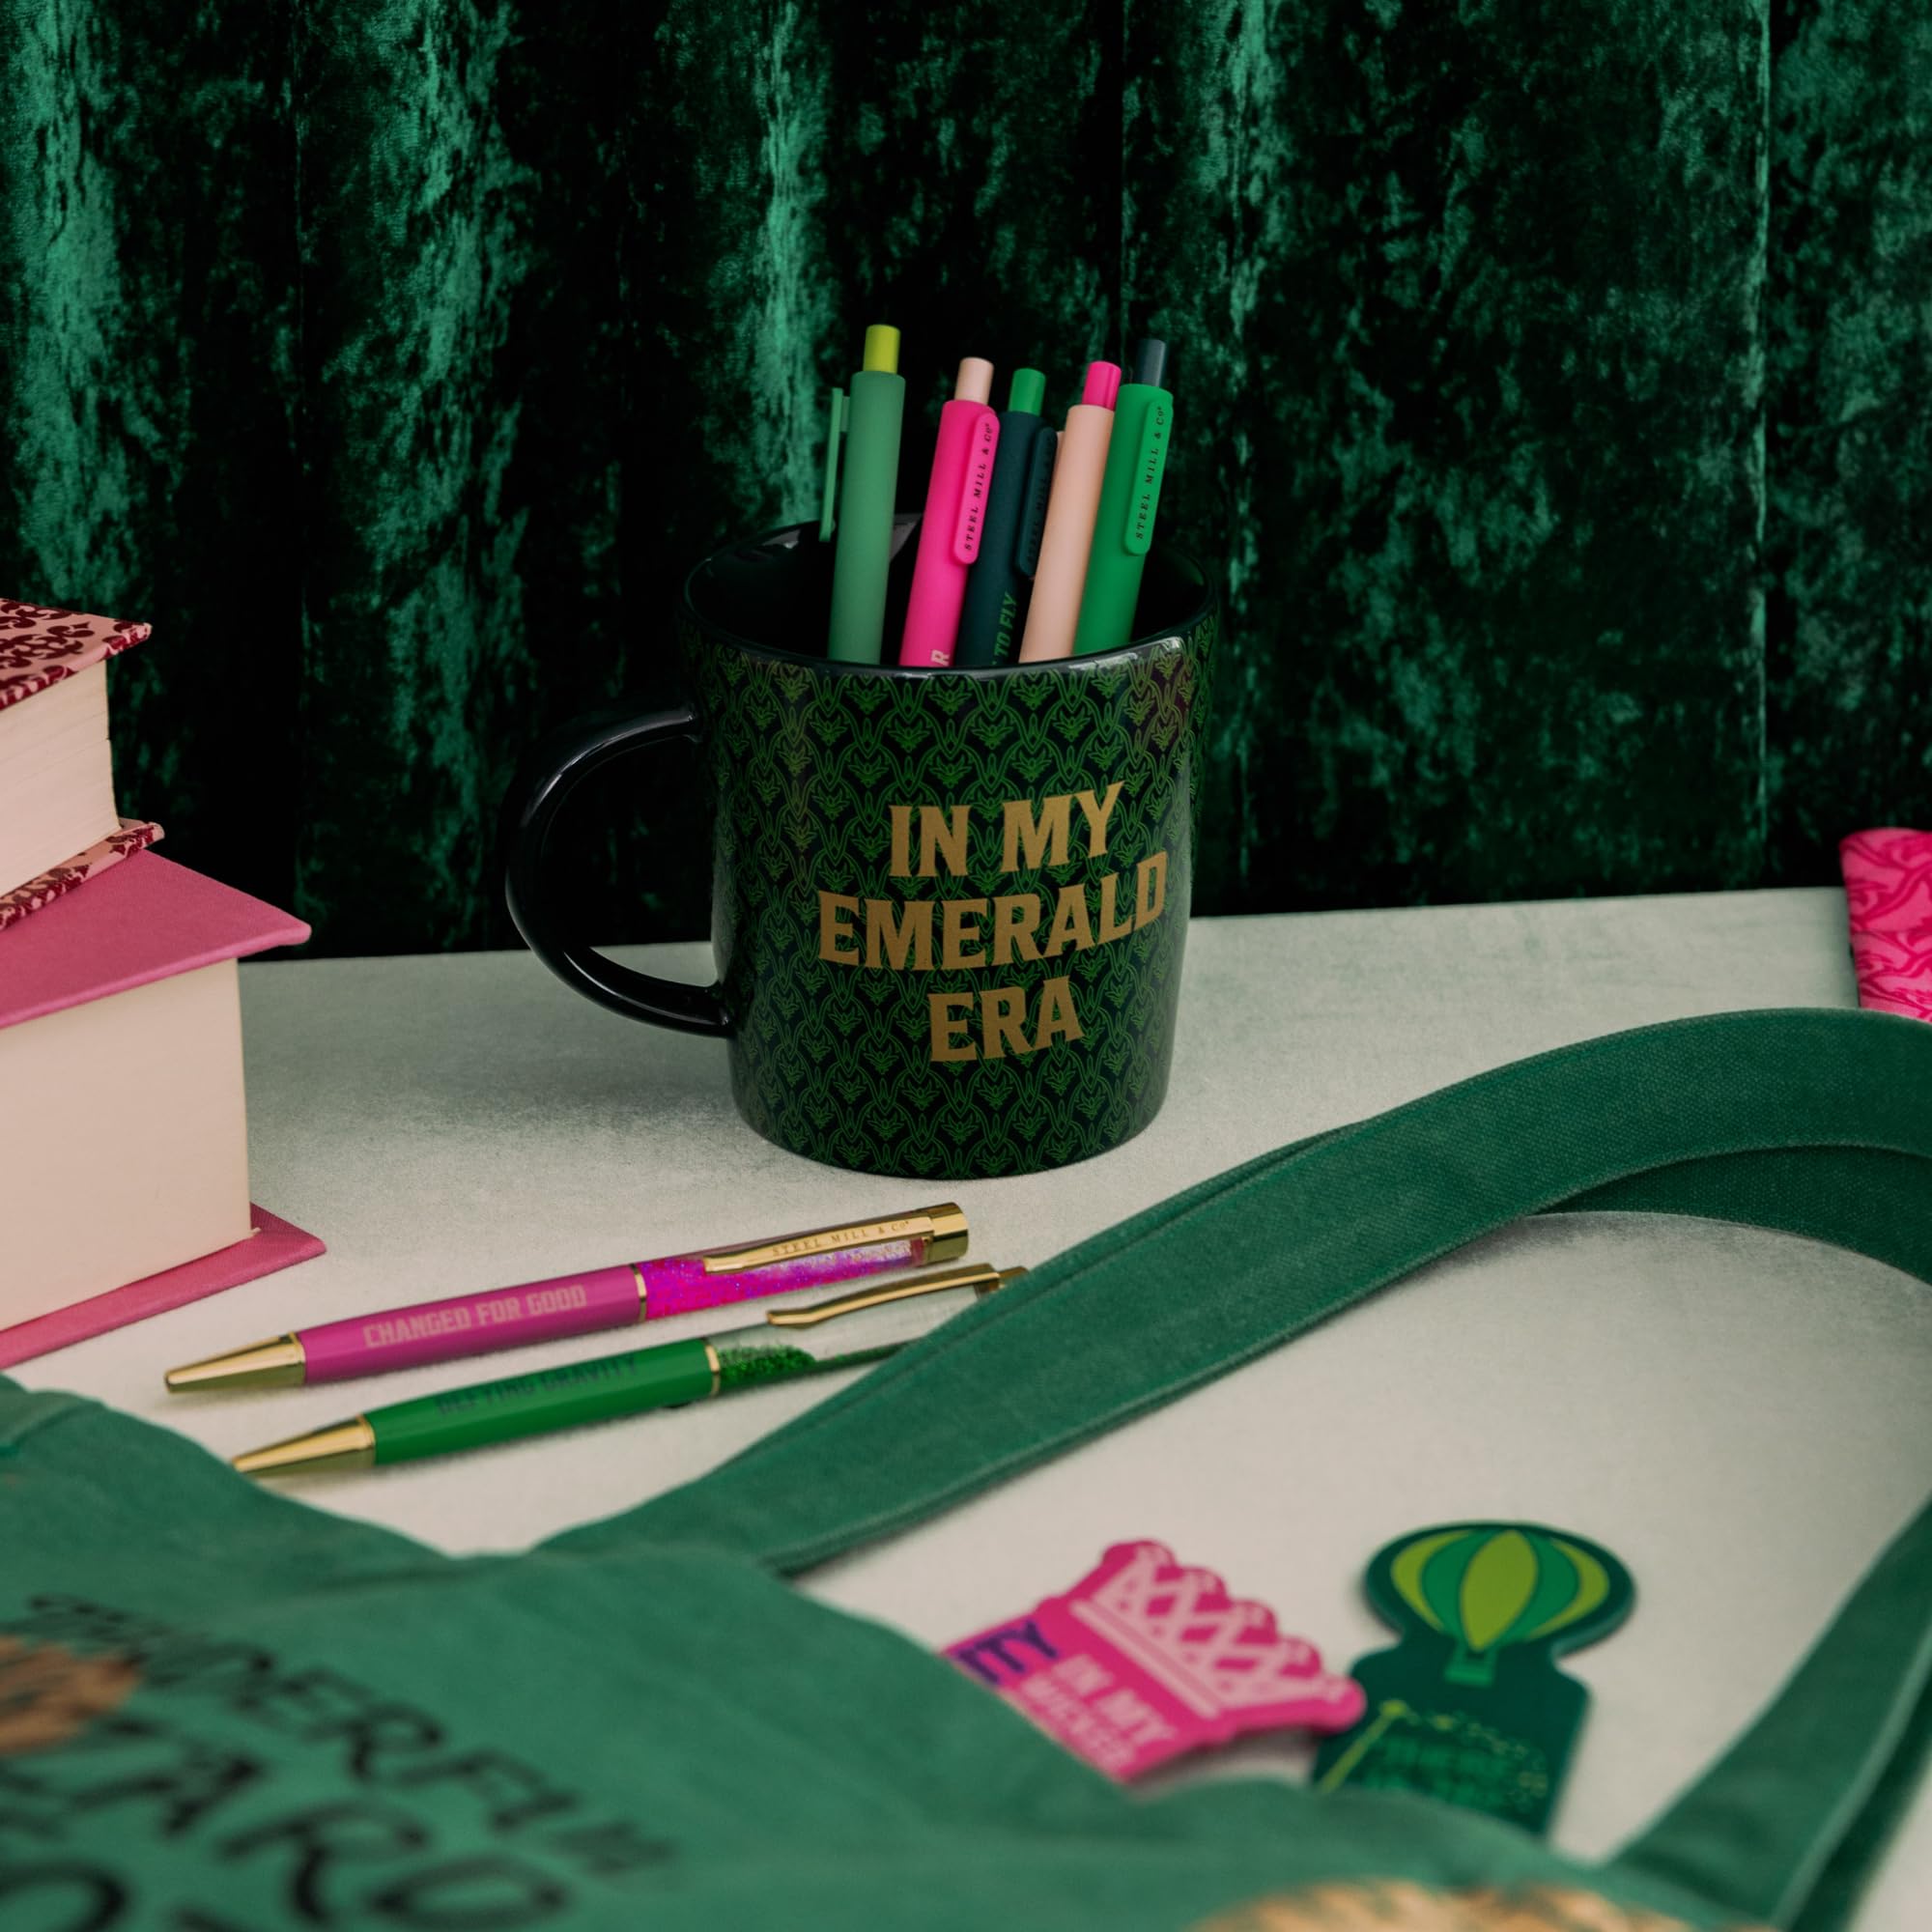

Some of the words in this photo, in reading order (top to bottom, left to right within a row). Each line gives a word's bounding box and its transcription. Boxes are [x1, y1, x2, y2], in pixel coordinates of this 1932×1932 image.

[964, 506, 979, 551] STEEL
[974, 463, 986, 498] MILL
[1136, 494, 1151, 539] STEEL
[1145, 447, 1159, 484] MILL
[993, 632, 1011, 657] TO
[999, 590, 1017, 630] FLY
[889, 804, 971, 878] IN
[1000, 781, 1125, 873] MY
[818, 850, 1168, 972] EMERALD
[927, 975, 1085, 1063] ERA
[773, 1237, 821, 1255] STEEL
[831, 1229, 867, 1242] MILL
[362, 1306, 471, 1349] CHANGED
[478, 1295, 522, 1326] FOR
[525, 1285, 587, 1315] GOOD
